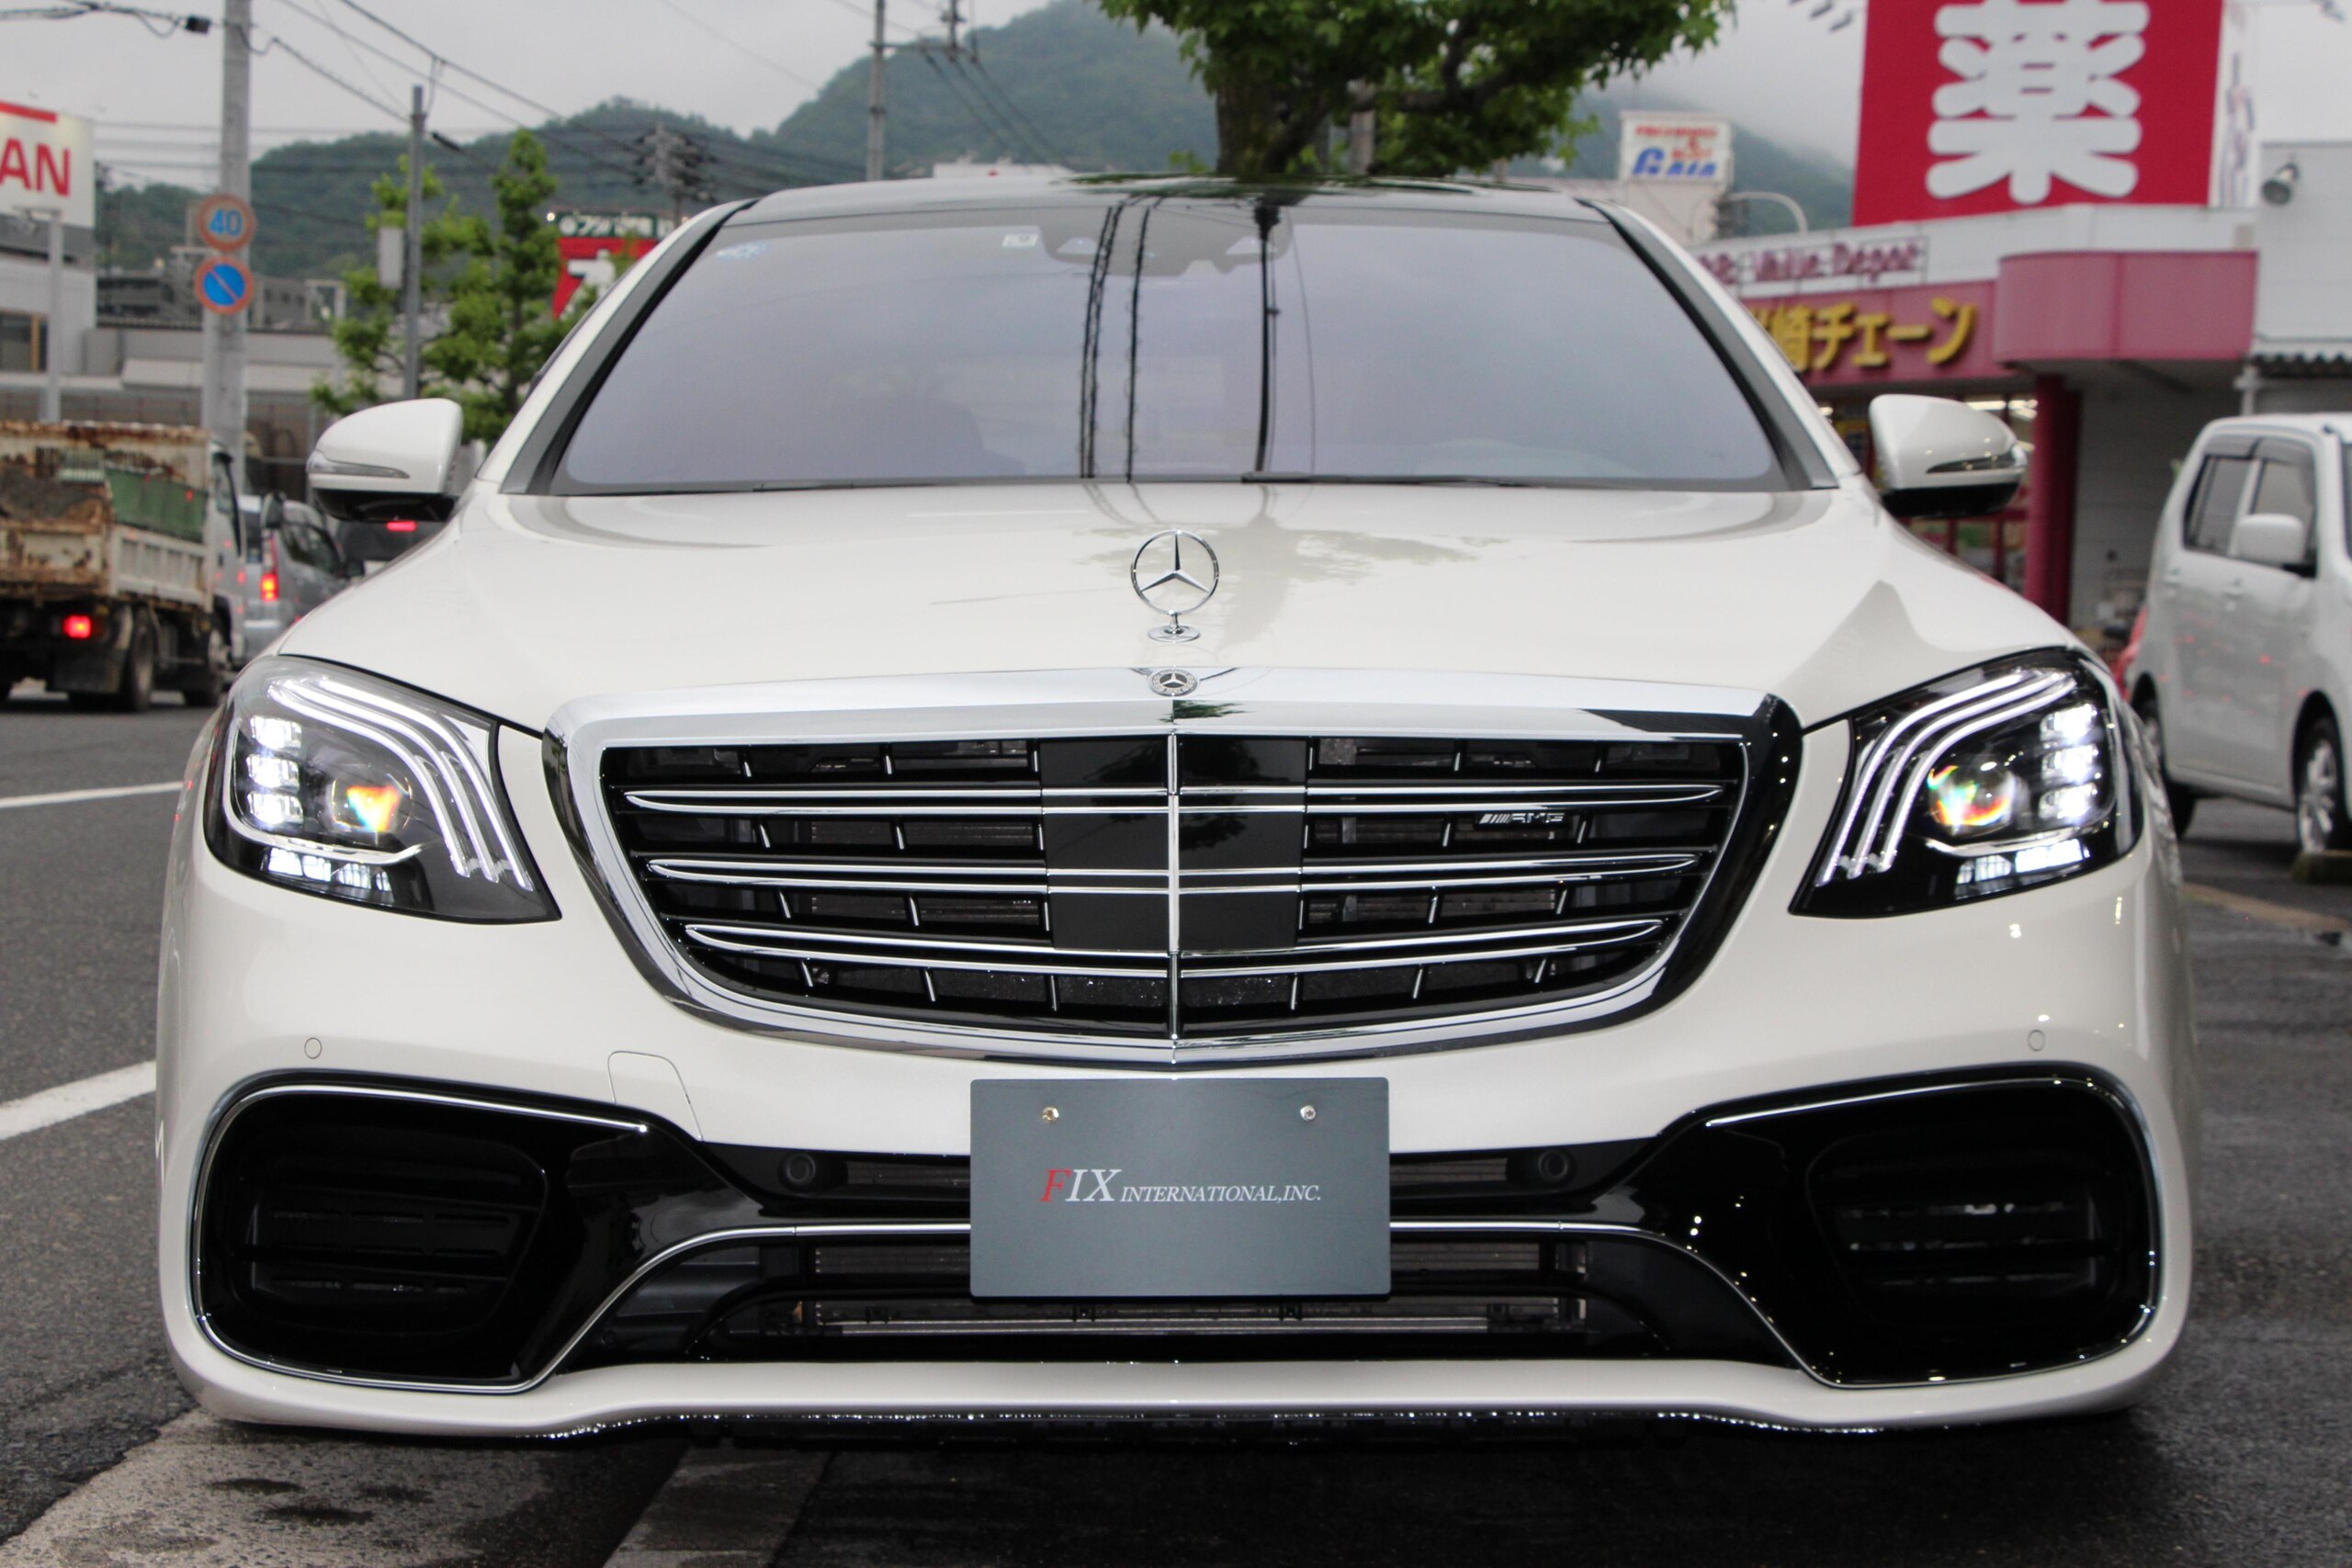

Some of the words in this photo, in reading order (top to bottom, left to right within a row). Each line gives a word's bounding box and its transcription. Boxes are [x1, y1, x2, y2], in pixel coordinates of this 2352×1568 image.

[1925, 0, 2151, 205] 薬
[0, 137, 71, 197] AN
[208, 209, 244, 236] 40
[1832, 240, 1917, 284] Depot
[1039, 1168, 1122, 1202] FIX
